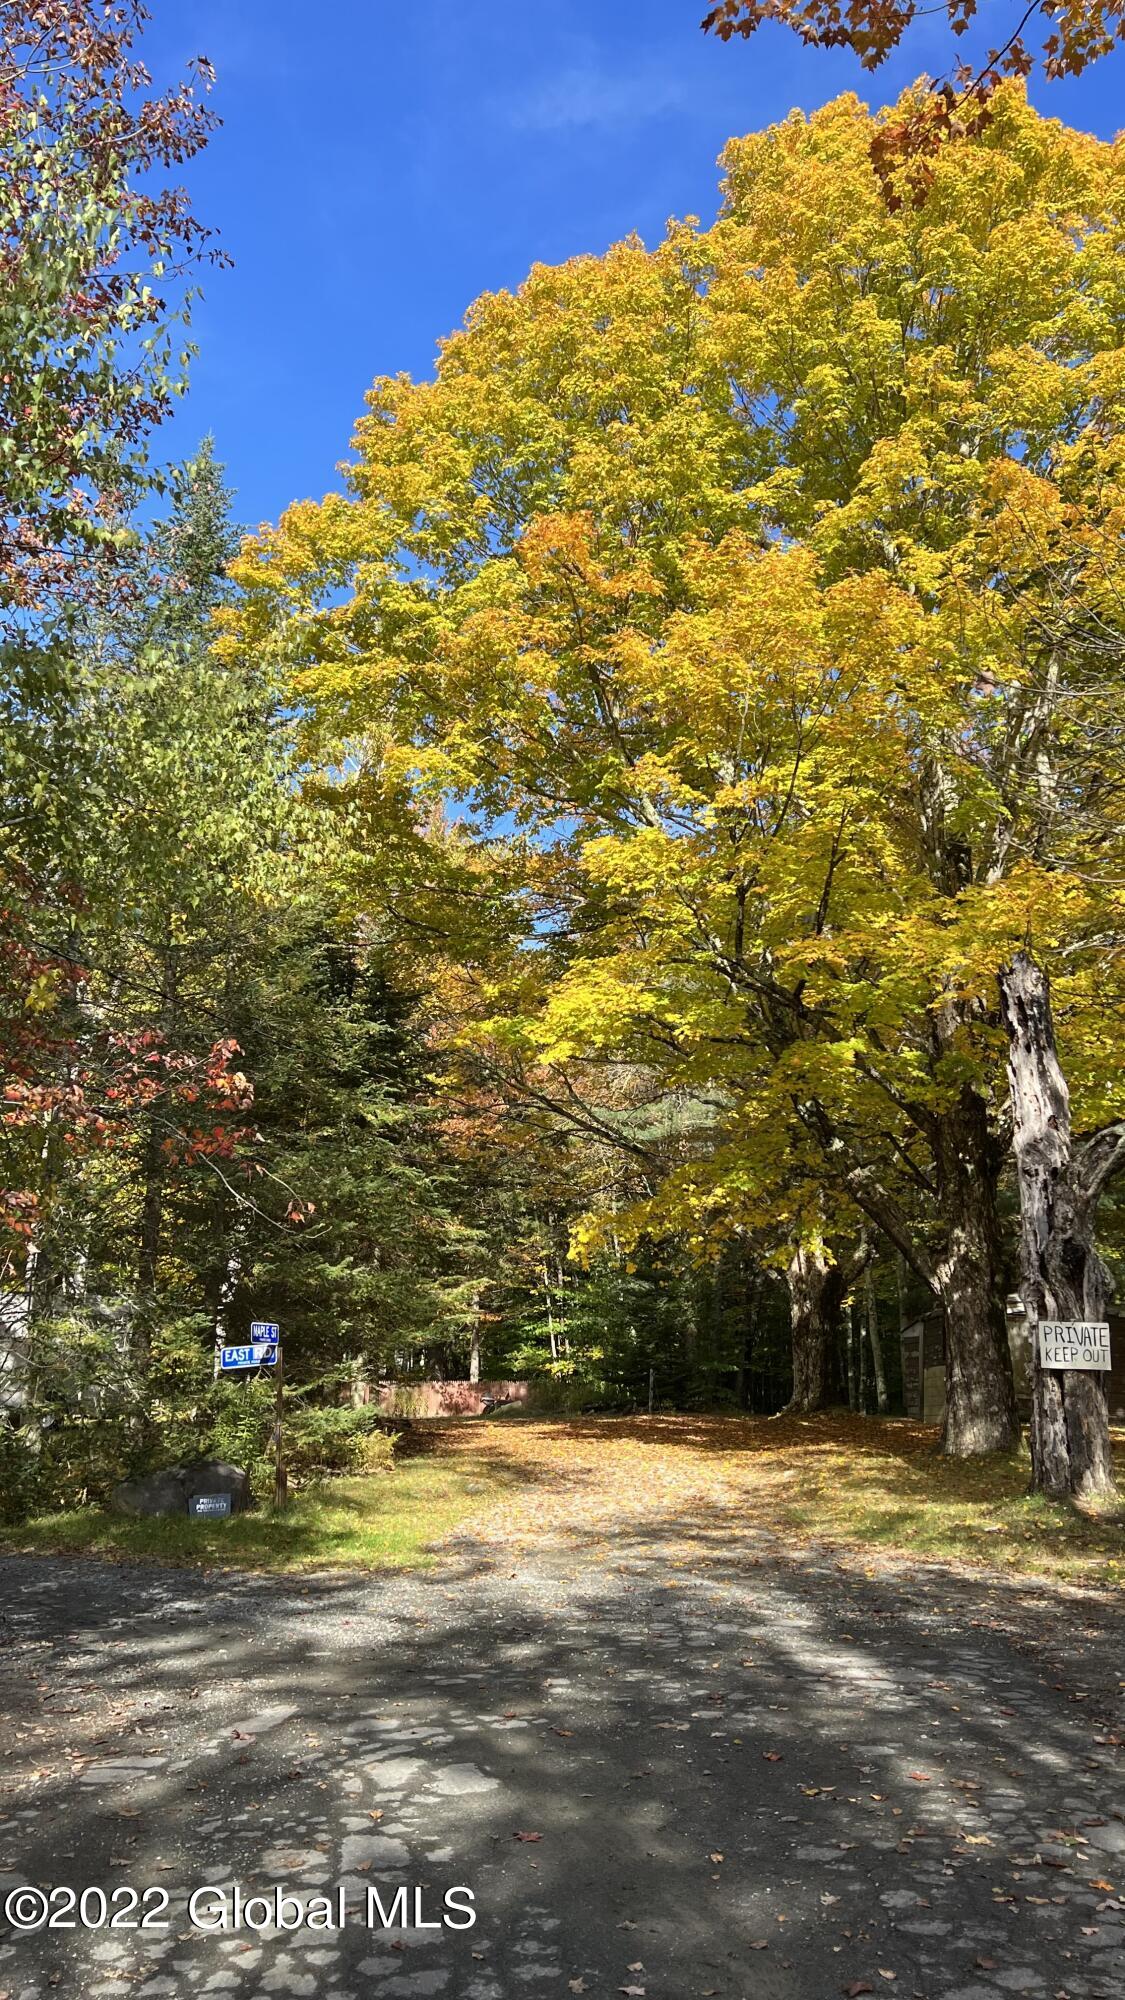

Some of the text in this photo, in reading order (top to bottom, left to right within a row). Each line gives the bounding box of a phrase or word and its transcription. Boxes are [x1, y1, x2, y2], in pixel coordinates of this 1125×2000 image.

[253, 1325, 277, 1338] MAPLE ST
[1043, 1325, 1109, 1347] PRIVATE
[225, 1347, 272, 1362] EAST RD
[1045, 1346, 1109, 1363] KEEP OUT
